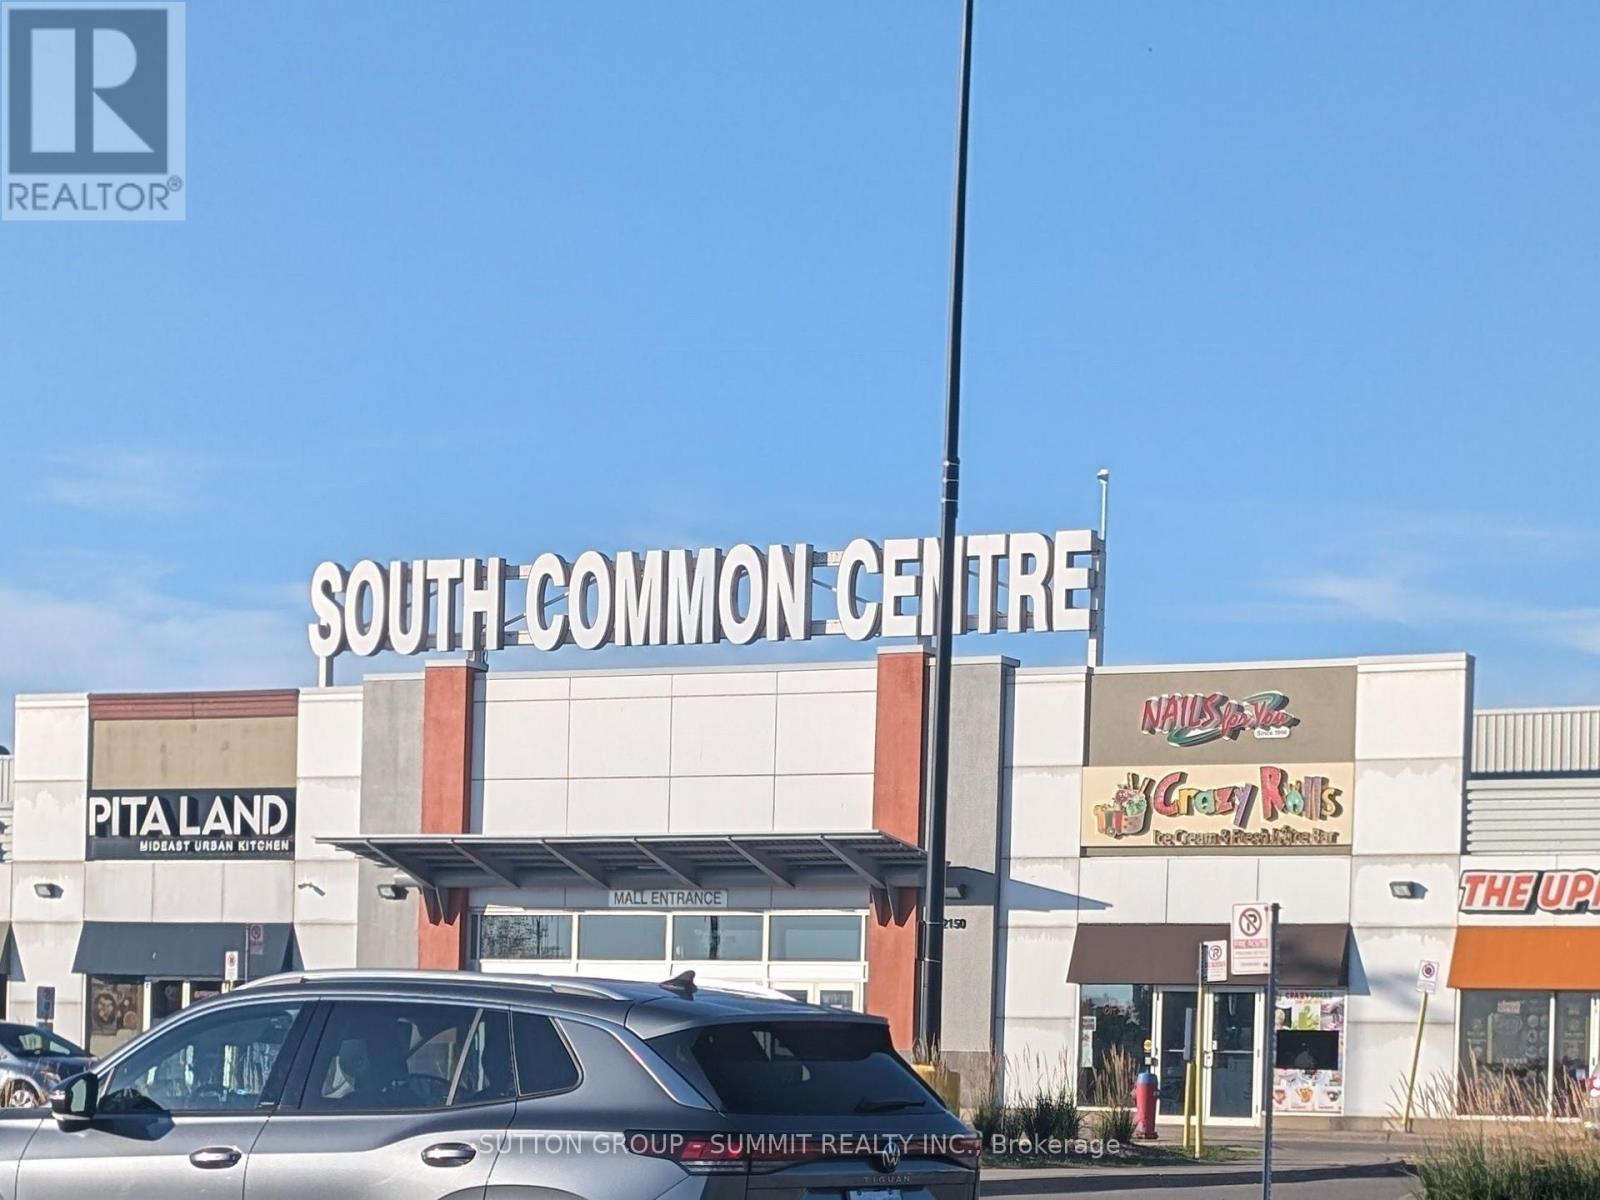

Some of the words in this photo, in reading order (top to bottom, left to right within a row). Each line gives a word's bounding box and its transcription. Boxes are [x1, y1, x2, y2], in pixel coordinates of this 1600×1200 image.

[308, 556, 504, 656] SOUTH
[525, 543, 813, 651] COMMON
[836, 529, 1094, 641] CENTRE
[1142, 692, 1226, 734] NAILS
[1220, 699, 1250, 740] for
[1252, 701, 1290, 727] You
[1153, 771, 1258, 829] Crazy
[1259, 766, 1343, 822] Rolls
[88, 795, 171, 836] PITA
[178, 794, 289, 836] LAND
[139, 840, 191, 852] MIDEAST
[194, 839, 233, 852] URBAN
[237, 838, 290, 851] KITCHEN
[1153, 829, 1175, 846] Ice
[1175, 829, 1220, 846] Cream
[1232, 828, 1271, 845] Fresh
[1311, 827, 1340, 845] Bar
[614, 891, 648, 905] MALL
[651, 891, 722, 905] ENTRANCE
[1462, 872, 1537, 910] THE
[1539, 872, 1600, 910] UP
[943, 918, 967, 930] 2150
[863, 1175, 911, 1184] TIGUAN
